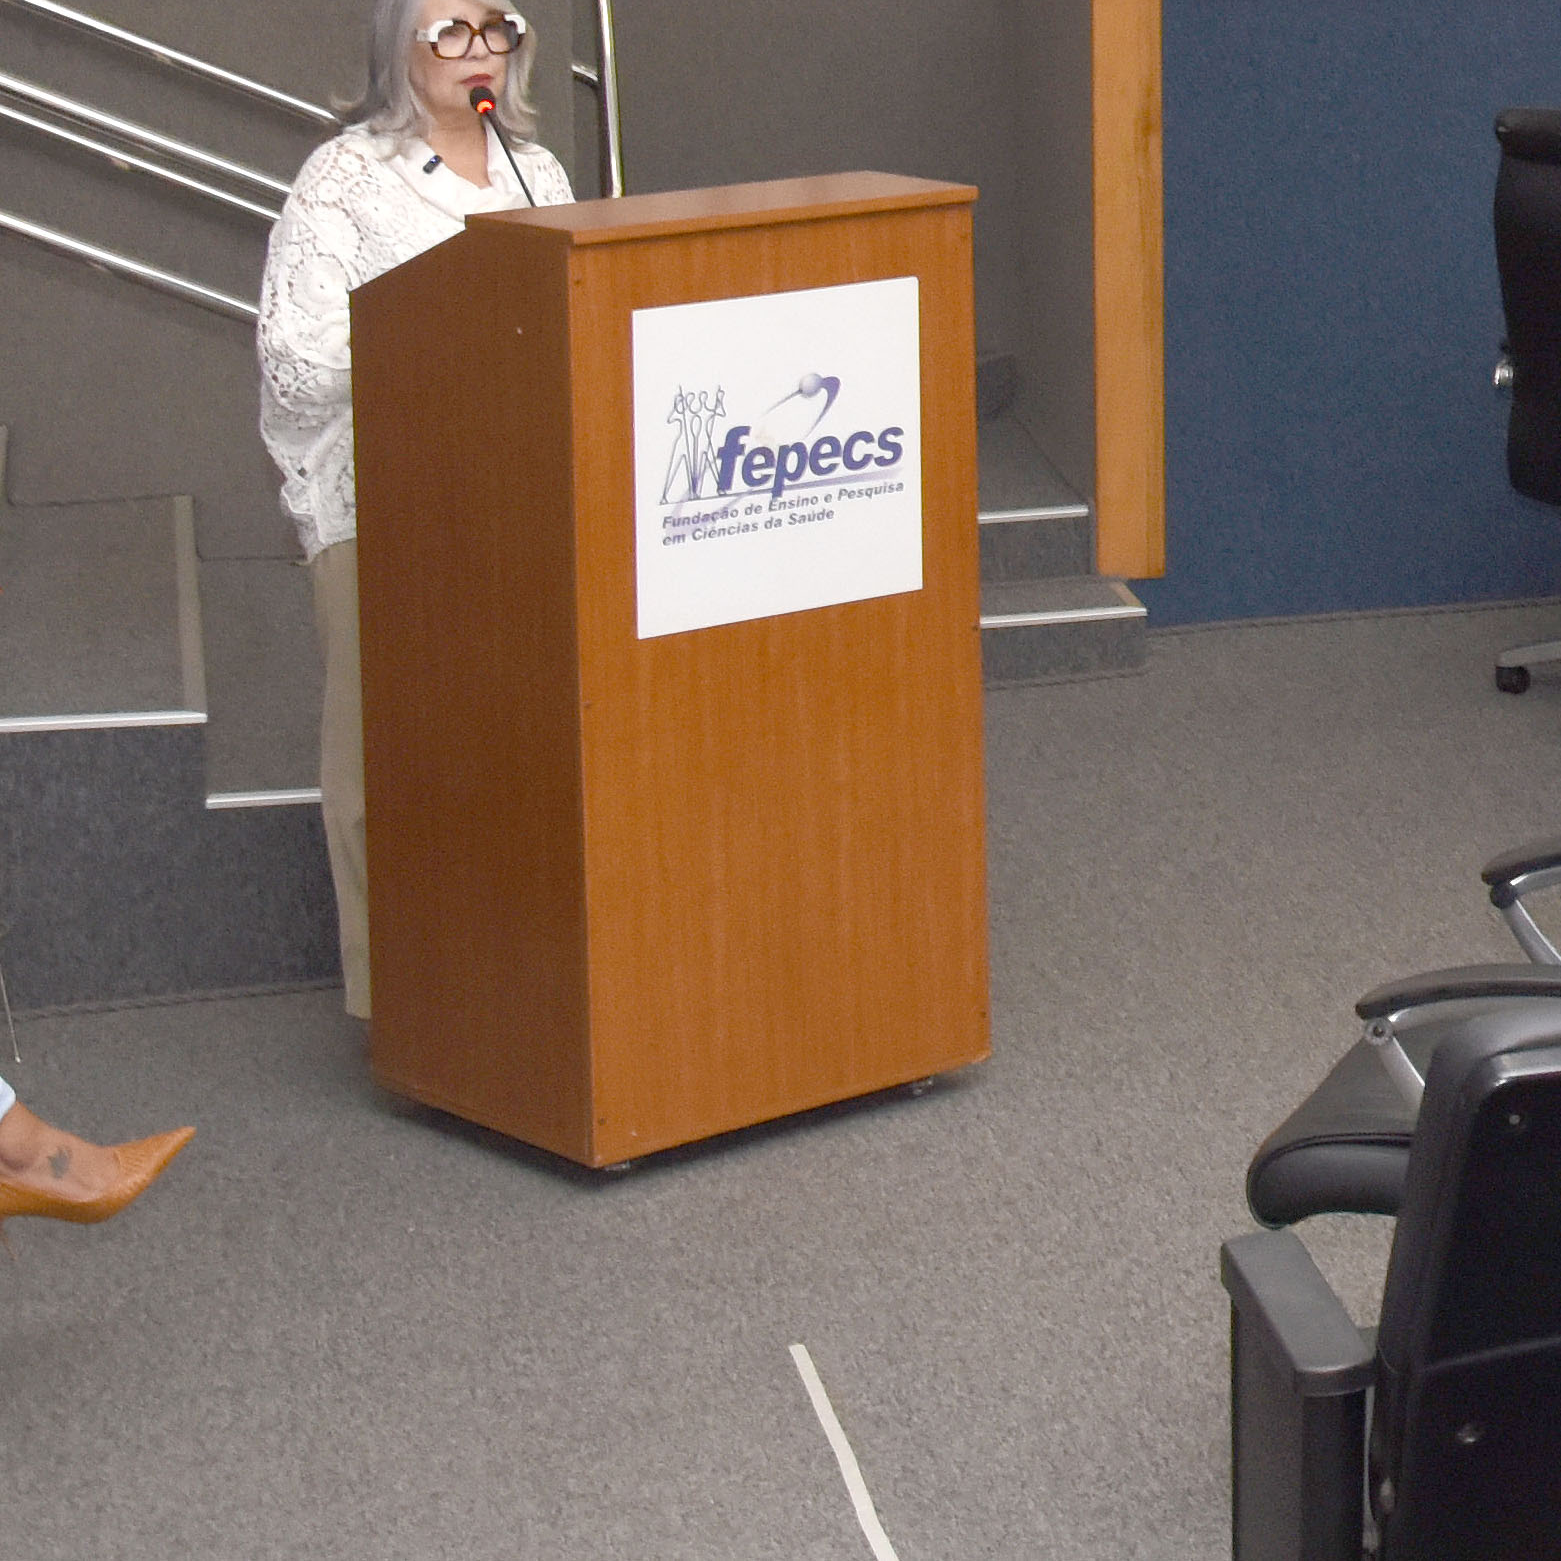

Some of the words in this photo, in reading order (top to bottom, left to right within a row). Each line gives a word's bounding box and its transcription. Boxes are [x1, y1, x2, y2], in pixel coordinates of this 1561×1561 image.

[716, 426, 904, 501] fepecs
[662, 535, 686, 546] em
[692, 521, 759, 541] Ciências
[764, 517, 782, 530] da
[788, 508, 834, 526] Saúde
[663, 508, 739, 529] Fundação
[744, 505, 762, 516] de
[768, 496, 818, 513] Ensino
[824, 494, 832, 504] e
[838, 481, 904, 501] Pesquisa
